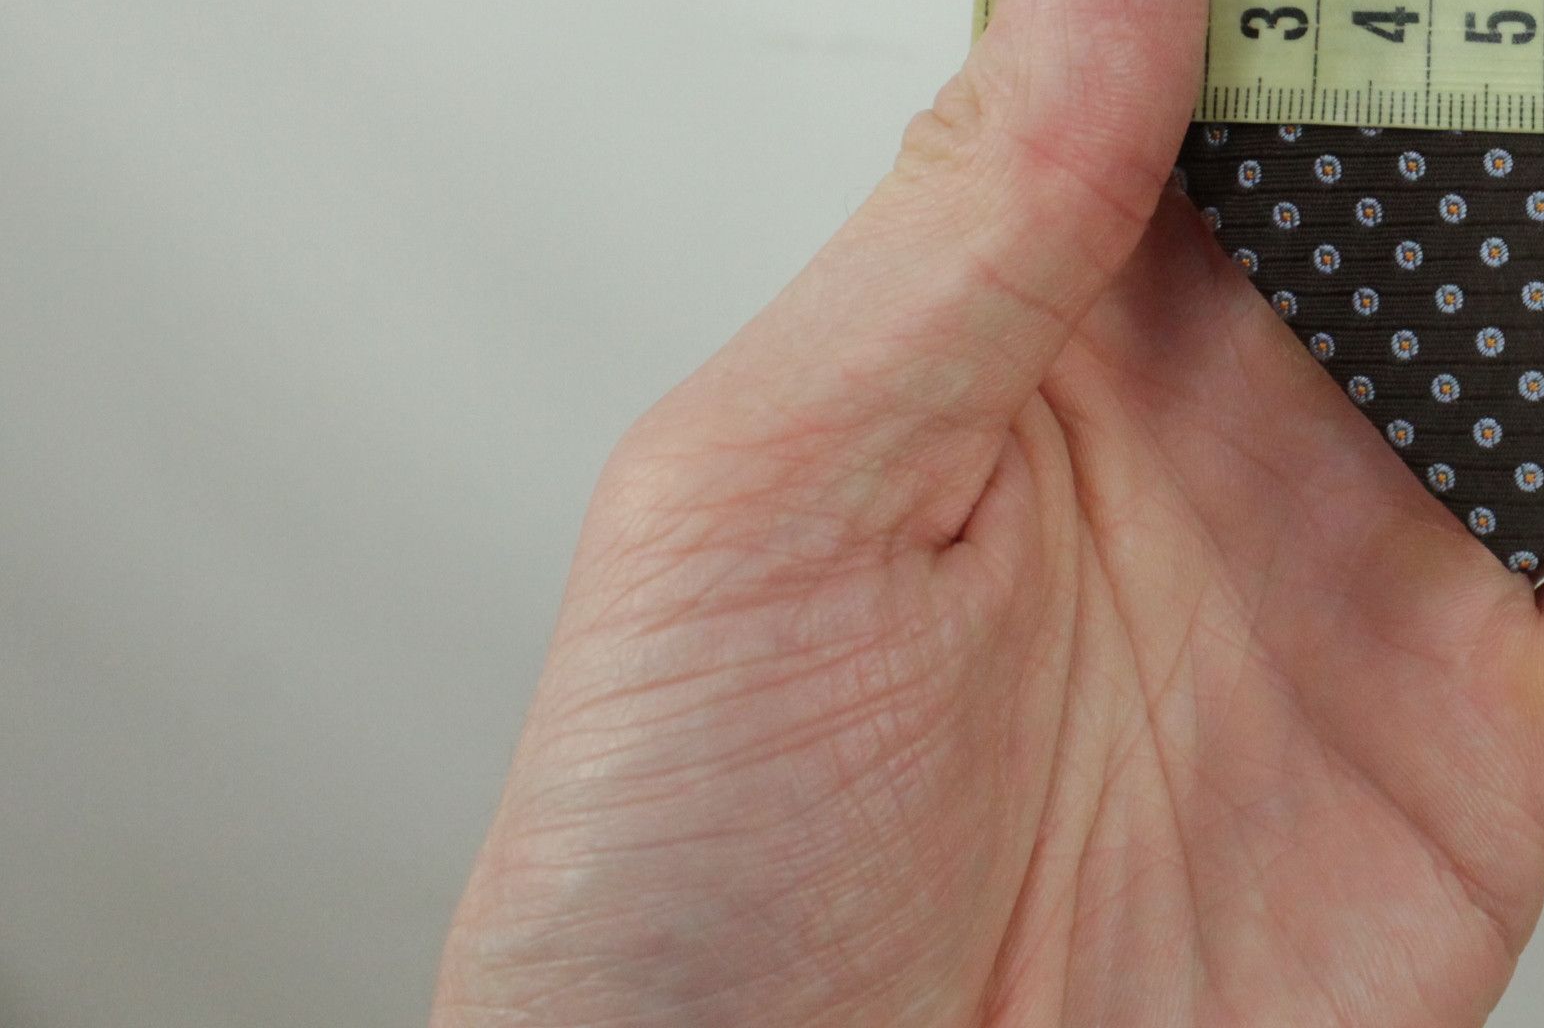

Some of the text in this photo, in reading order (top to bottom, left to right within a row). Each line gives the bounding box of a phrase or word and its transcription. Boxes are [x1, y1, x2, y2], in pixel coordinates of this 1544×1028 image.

[1240, 6, 1309, 41] 3
[1352, 6, 1419, 43] 4
[1465, 9, 1537, 45] 5
